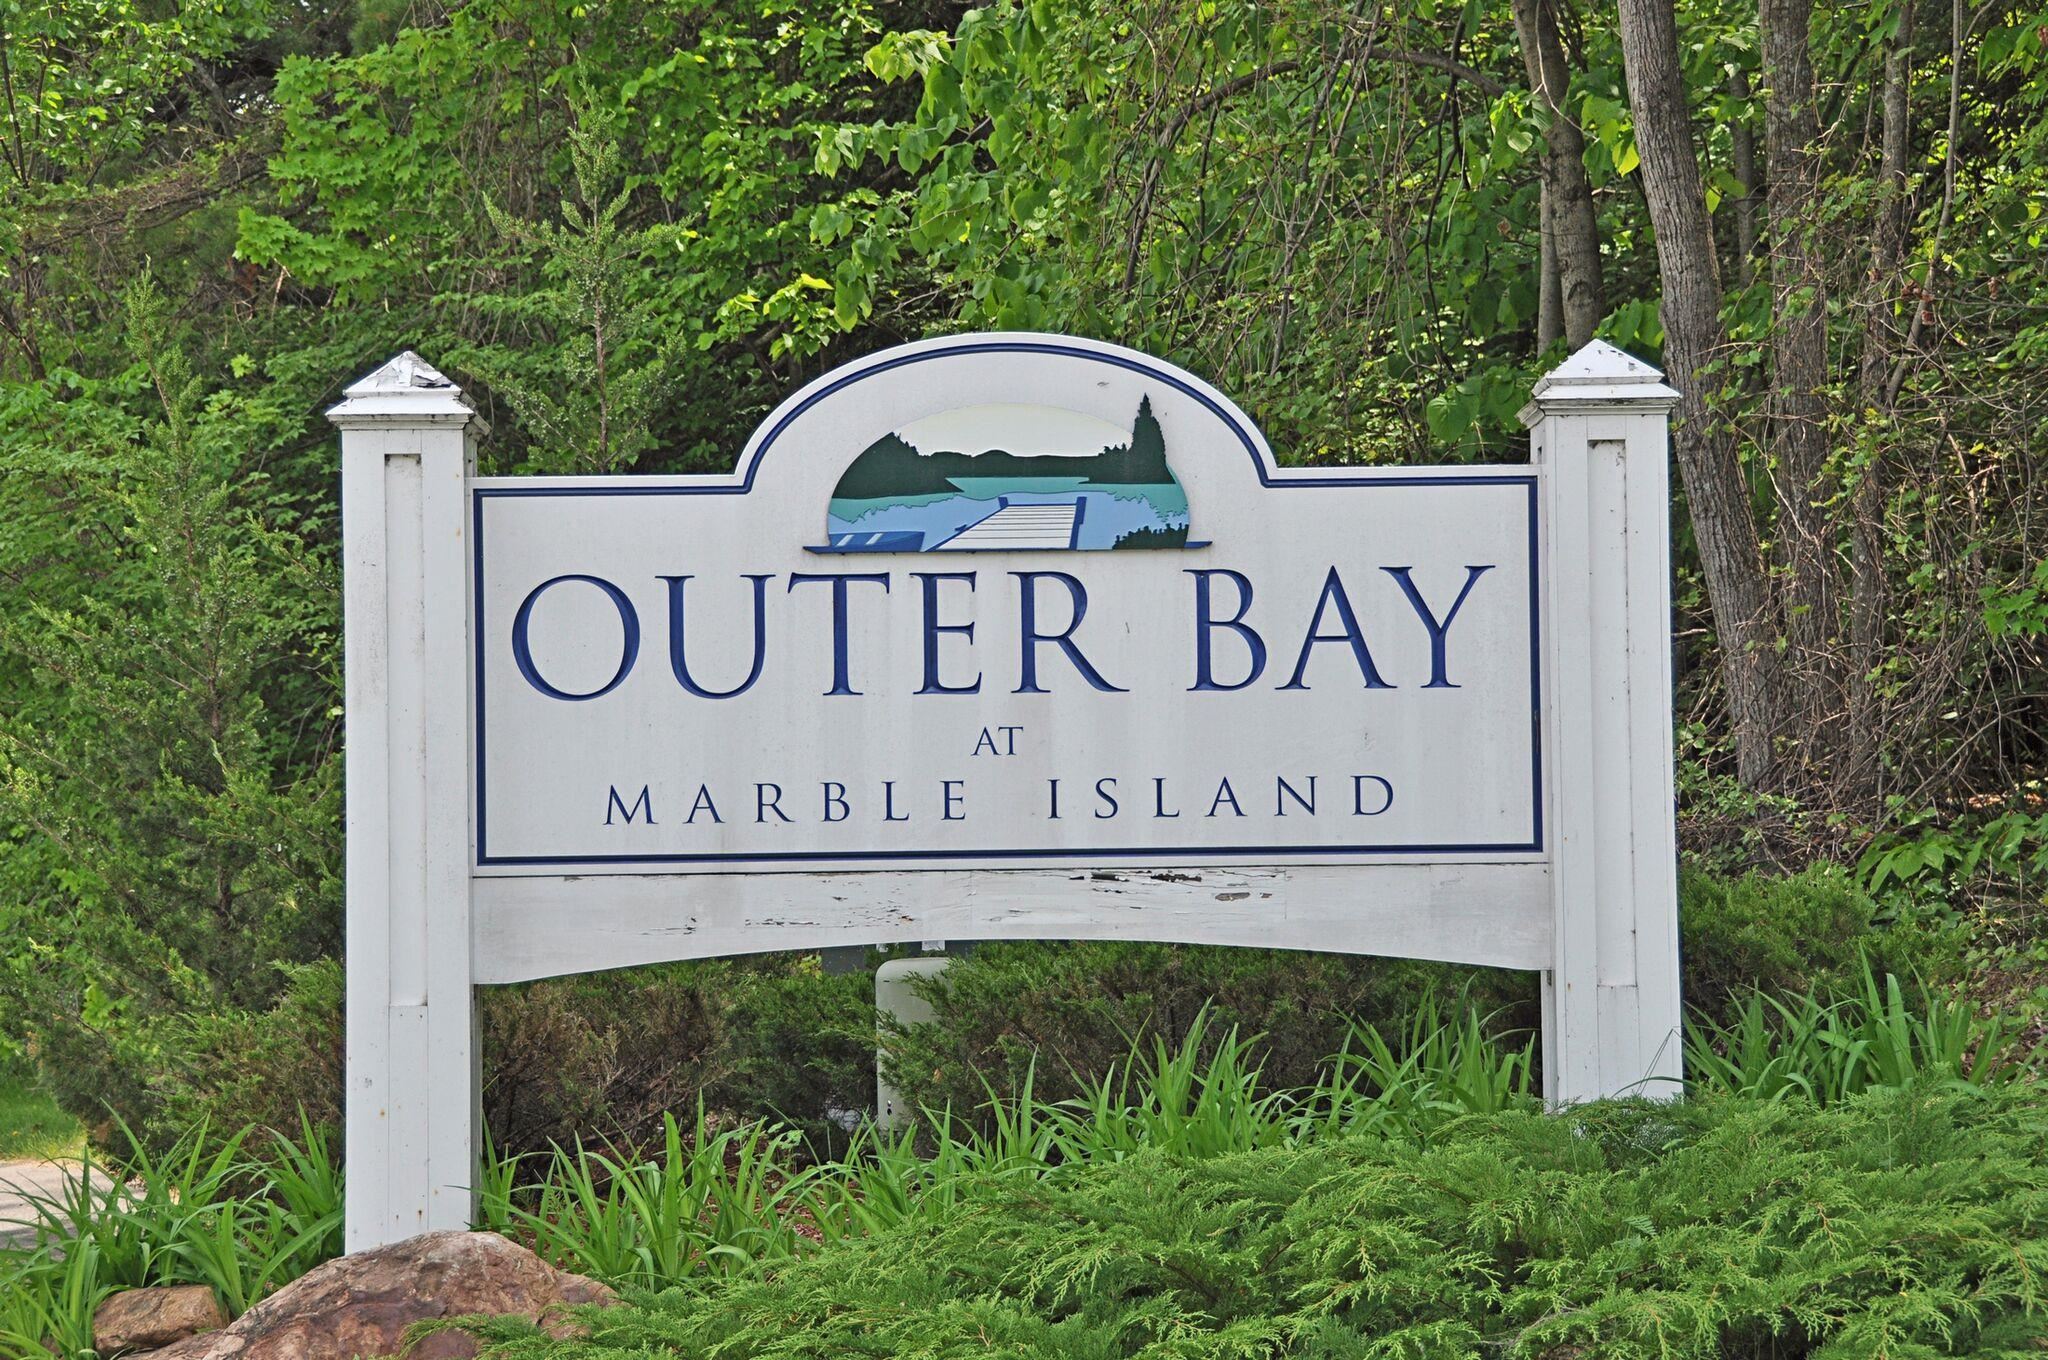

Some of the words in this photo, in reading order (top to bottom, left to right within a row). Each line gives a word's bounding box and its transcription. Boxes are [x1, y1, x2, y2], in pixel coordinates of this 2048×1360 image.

[511, 570, 1131, 702] OUTER
[1183, 564, 1498, 692] BAY
[970, 726, 1024, 757] AT
[603, 780, 966, 827] MARBLE
[1047, 775, 1395, 821] ISLAND
